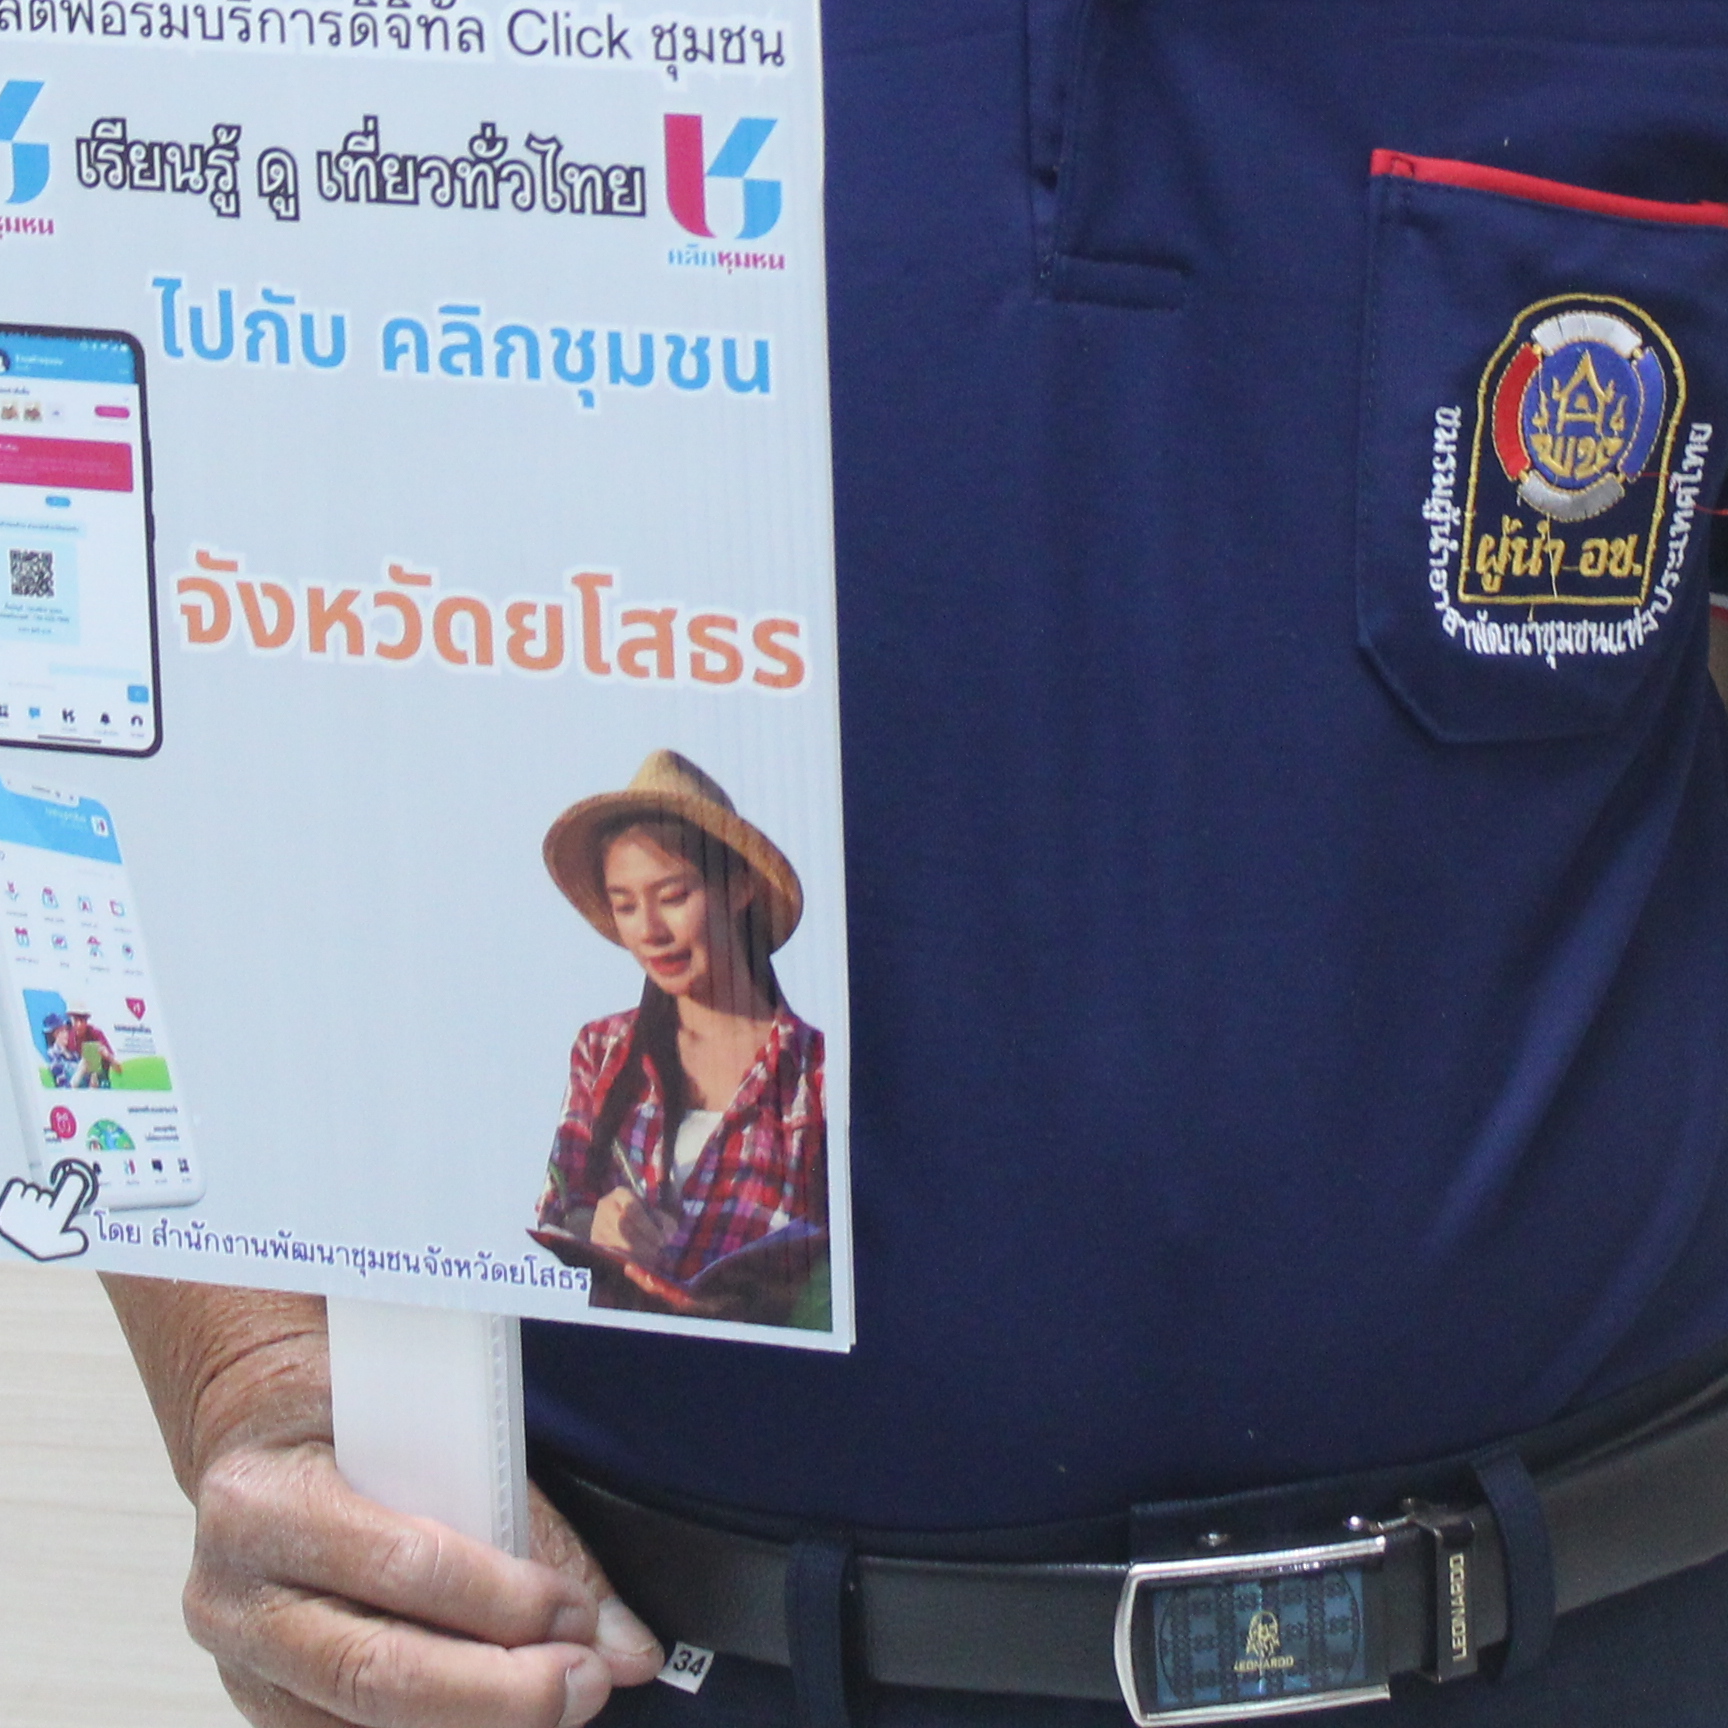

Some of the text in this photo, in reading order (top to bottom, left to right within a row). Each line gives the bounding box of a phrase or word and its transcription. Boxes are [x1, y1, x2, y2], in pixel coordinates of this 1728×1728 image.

[506, 7, 633, 62] Click
[652, 22, 786, 81] ชุมชน
[75, 116, 647, 221] เรียนรู้ ดู เที่ยวทั่วไทย
[151, 277, 773, 410] ไปกับ คลิกชุมชน
[1475, 514, 1566, 593] ผู้นำ
[174, 551, 810, 690] จังหวัดยโสธร
[93, 1210, 591, 1293] โดย สำนักงานพัฒนาชุมชนจังหวัดยโสธร
[1448, 1553, 1468, 1663] LEONARDO
[673, 1649, 708, 1677] 34
[1233, 1655, 1295, 1672] LEONARDO
